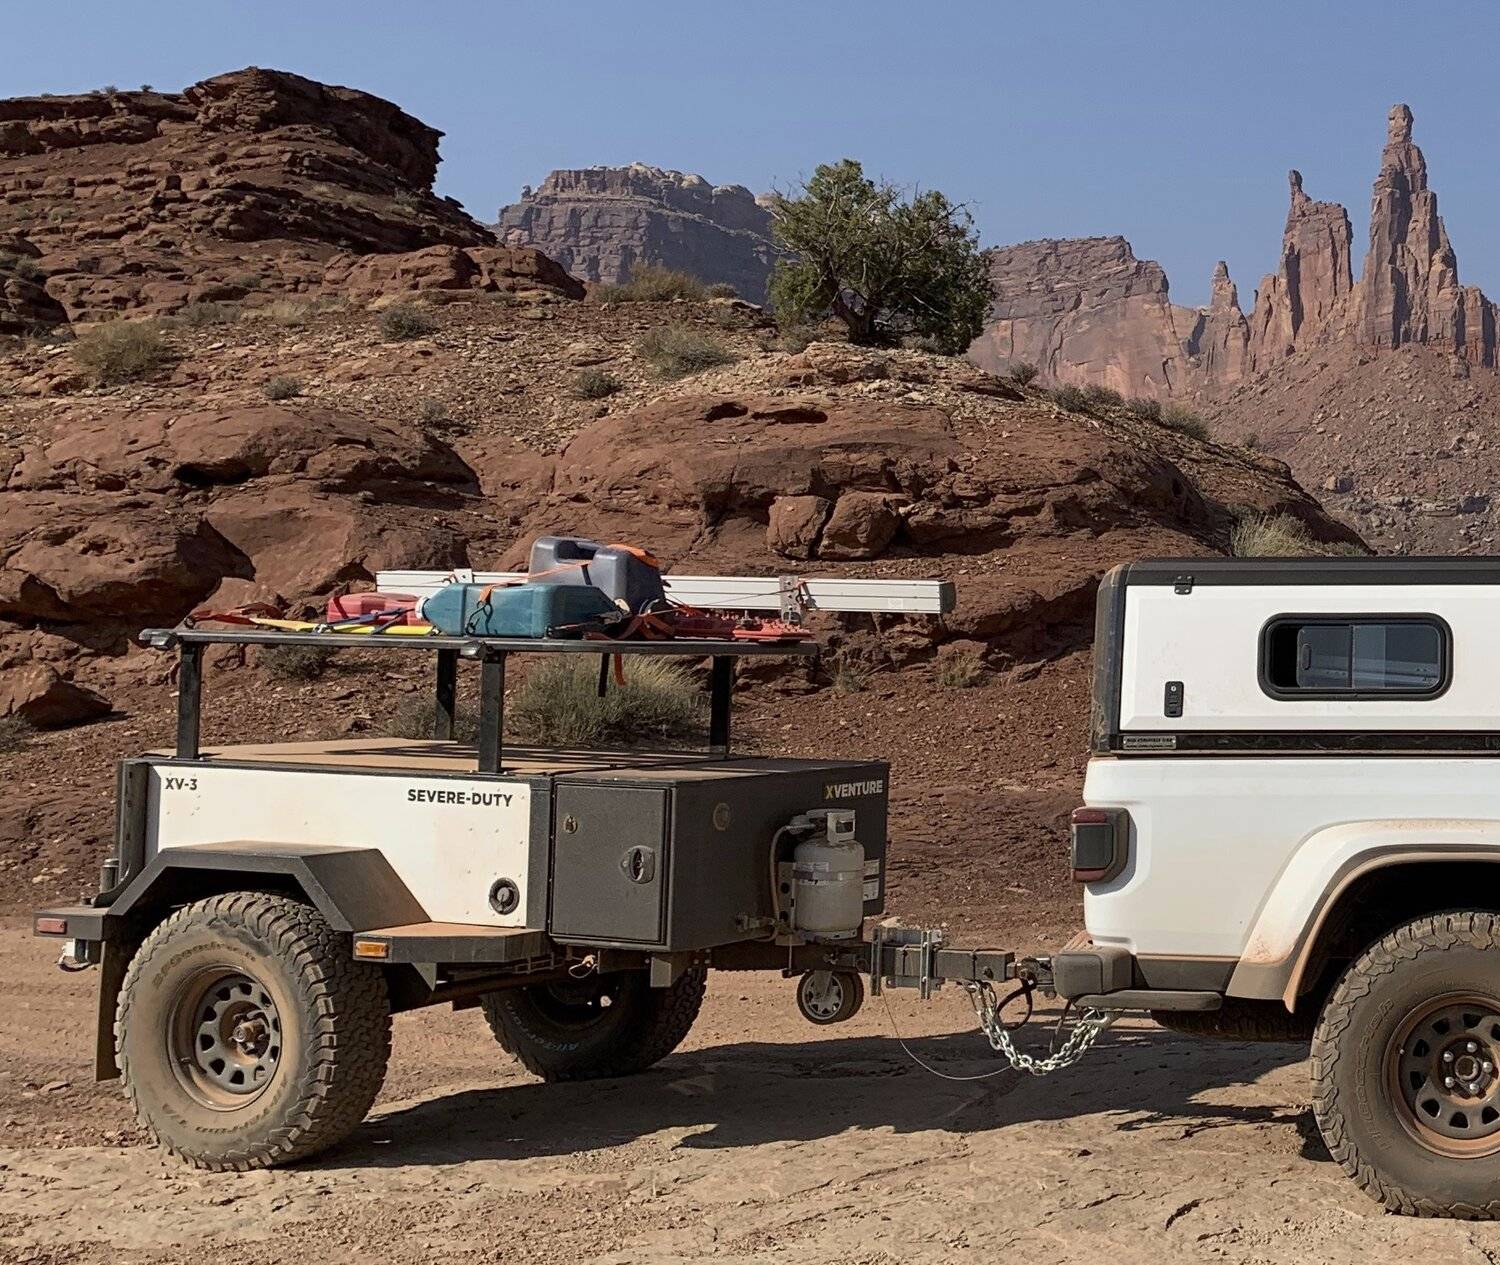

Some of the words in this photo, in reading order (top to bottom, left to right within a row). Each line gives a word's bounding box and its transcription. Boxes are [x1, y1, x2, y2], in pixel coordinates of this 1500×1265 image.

[165, 777, 197, 790] XV-3
[825, 780, 883, 799] XVENTURE
[407, 788, 513, 807] SEVERE-DUTY
